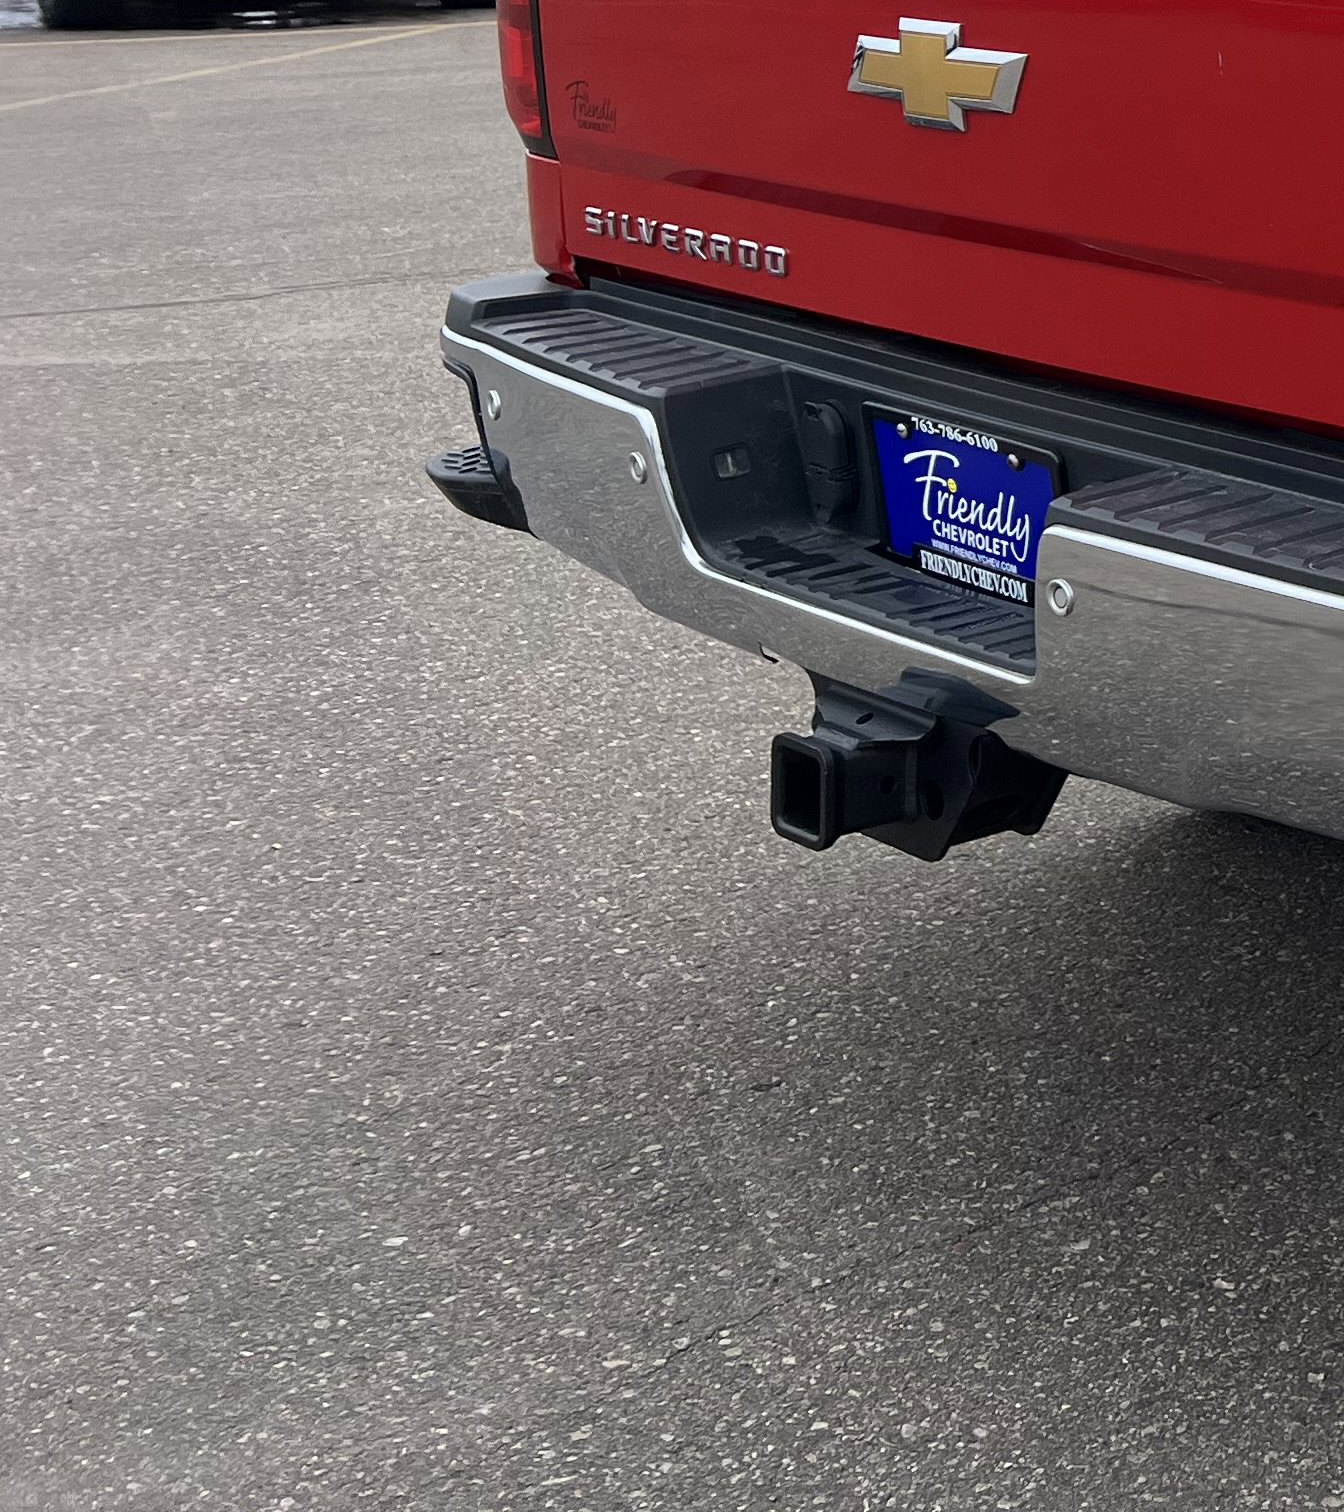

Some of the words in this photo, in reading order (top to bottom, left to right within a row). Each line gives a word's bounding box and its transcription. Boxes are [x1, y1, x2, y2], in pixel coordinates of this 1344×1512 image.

[584, 206, 788, 277] SILVERADO
[911, 416, 999, 453] 763-786-6100
[903, 449, 1031, 563] Friendly
[932, 519, 1009, 557] CHEVROLET
[919, 549, 1029, 603] FRIENDLYCHEV.COM
